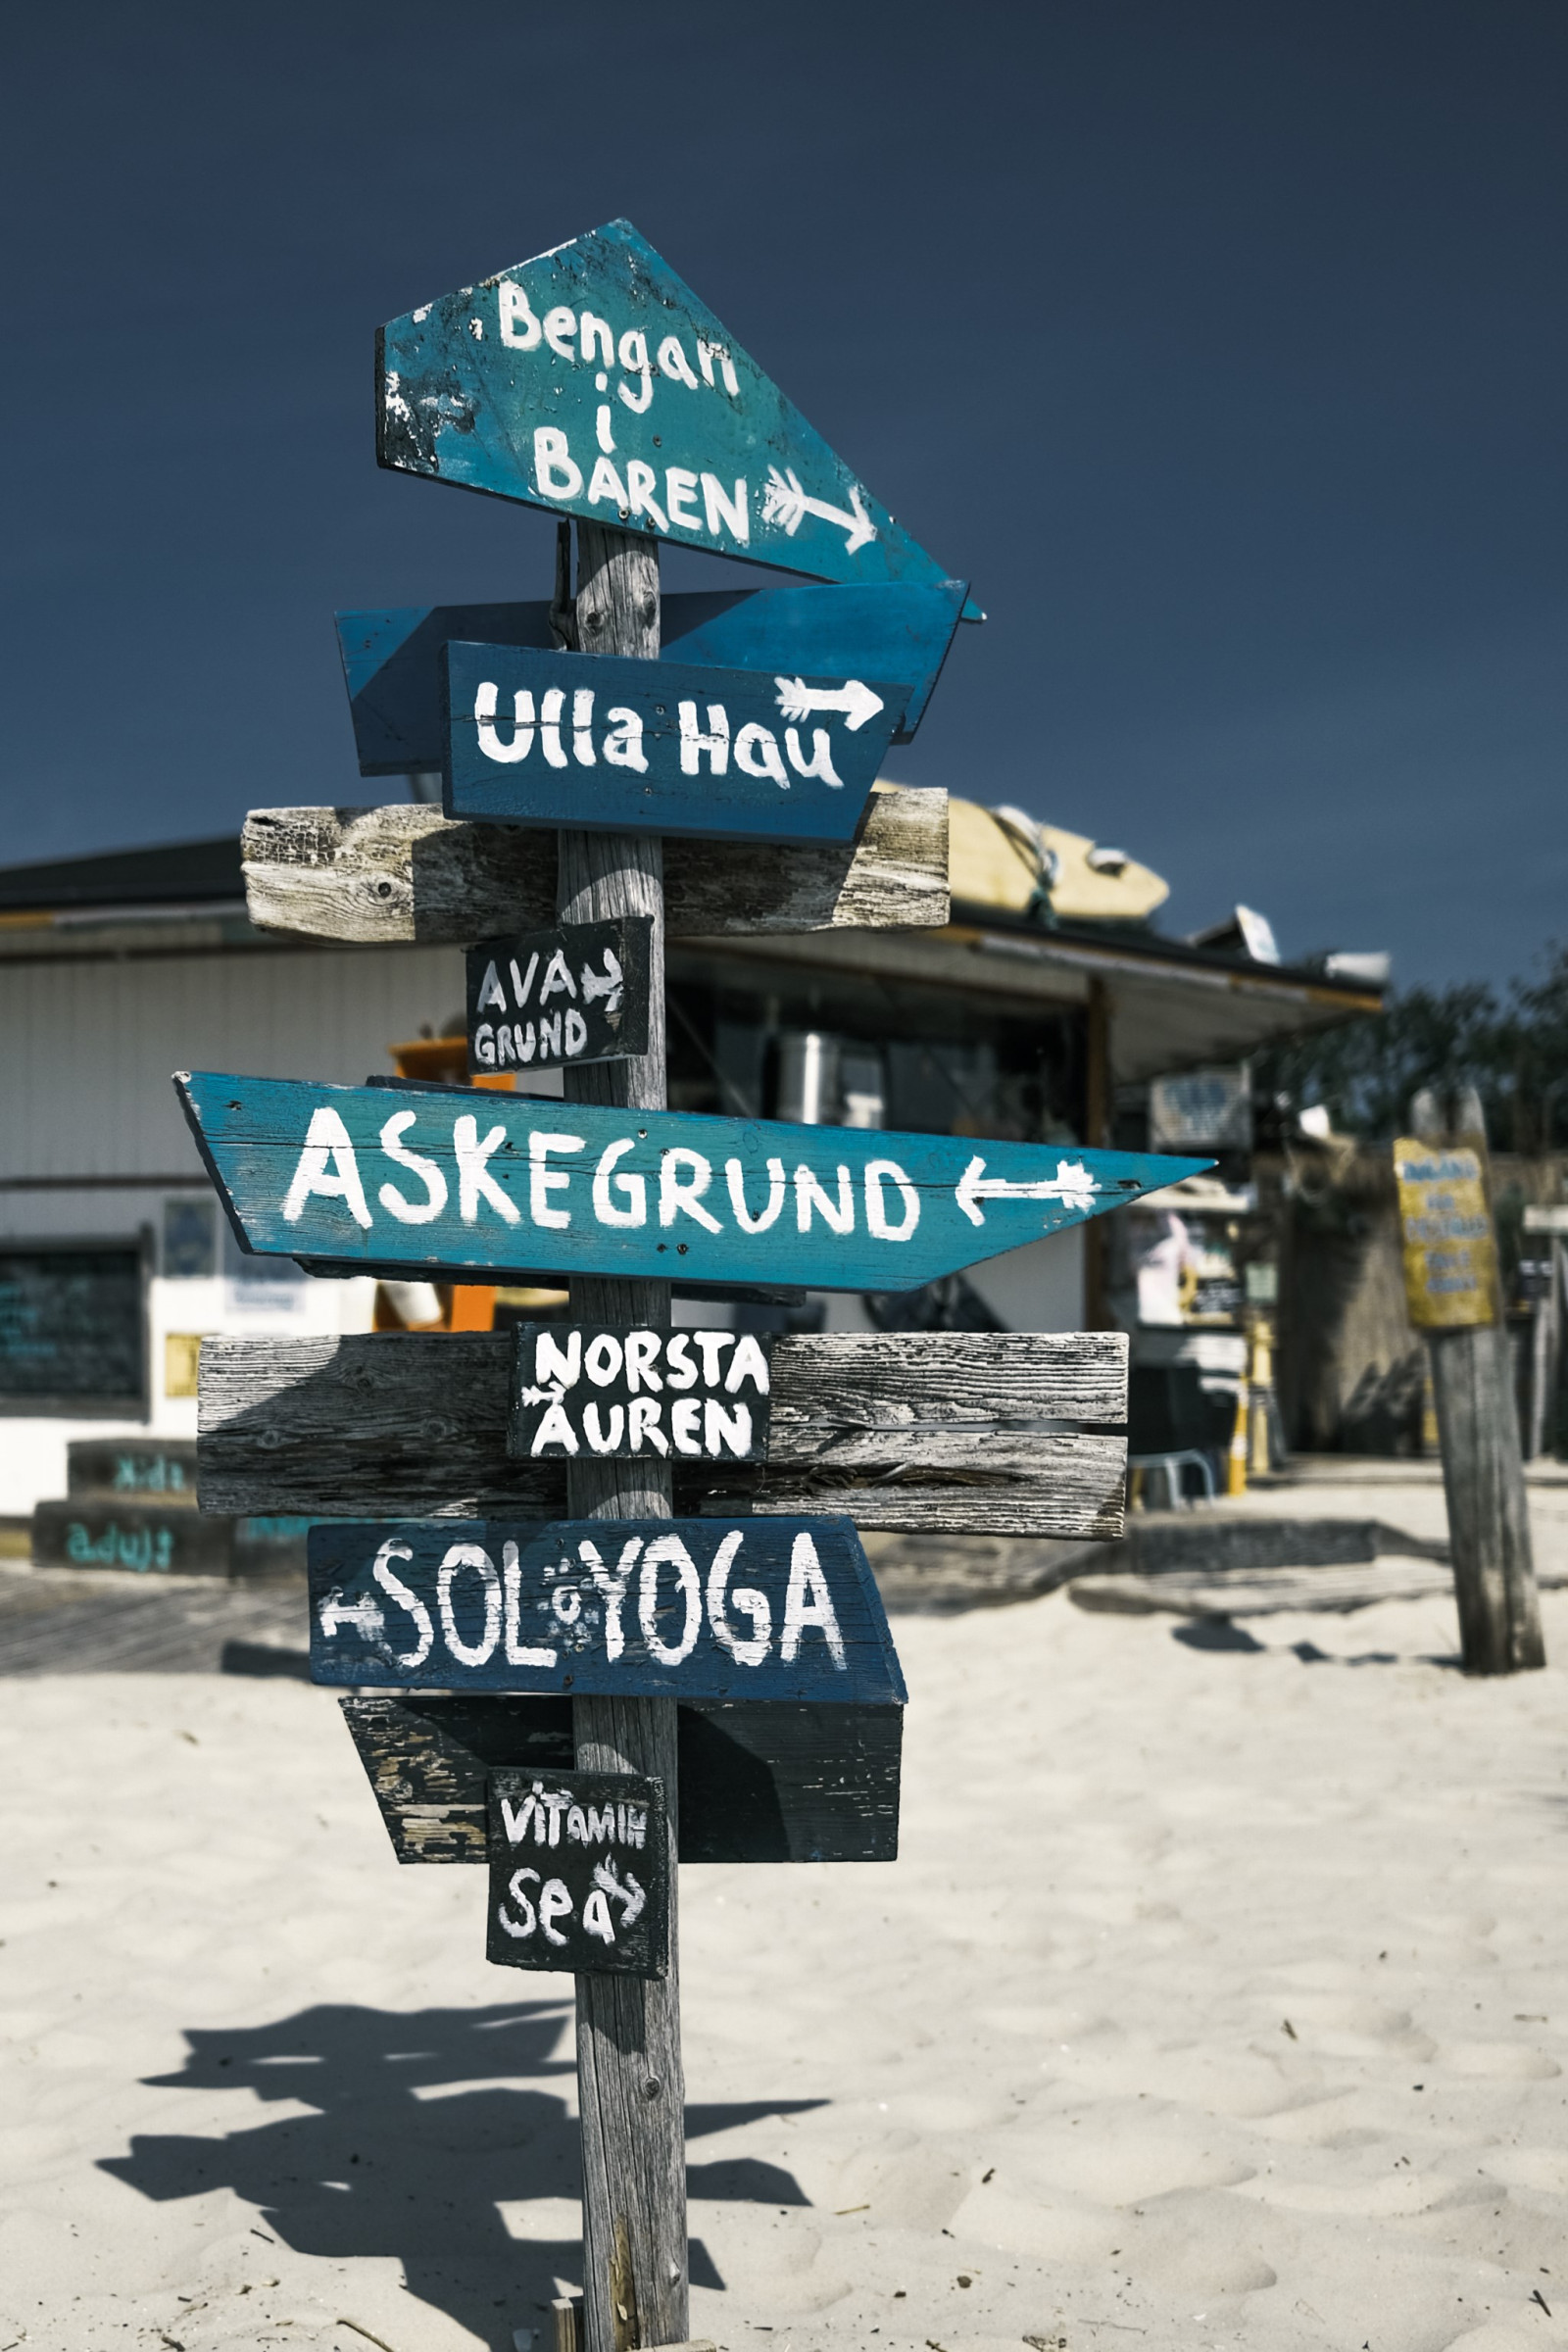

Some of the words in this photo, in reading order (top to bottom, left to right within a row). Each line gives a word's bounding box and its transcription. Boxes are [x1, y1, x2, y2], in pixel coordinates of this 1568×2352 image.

[498, 280, 740, 414] Bengan
[595, 372, 617, 454] i
[534, 426, 750, 547] BAREN
[475, 682, 649, 773] Ulla
[678, 700, 844, 789] Hau
[476, 948, 577, 1013] AVA
[474, 1007, 588, 1065] GRUND
[281, 1106, 921, 1242] ASKEGRUND
[535, 1330, 770, 1396] NORSTA
[372, 1538, 558, 1667] SOL
[577, 1530, 847, 1670] YOGA
